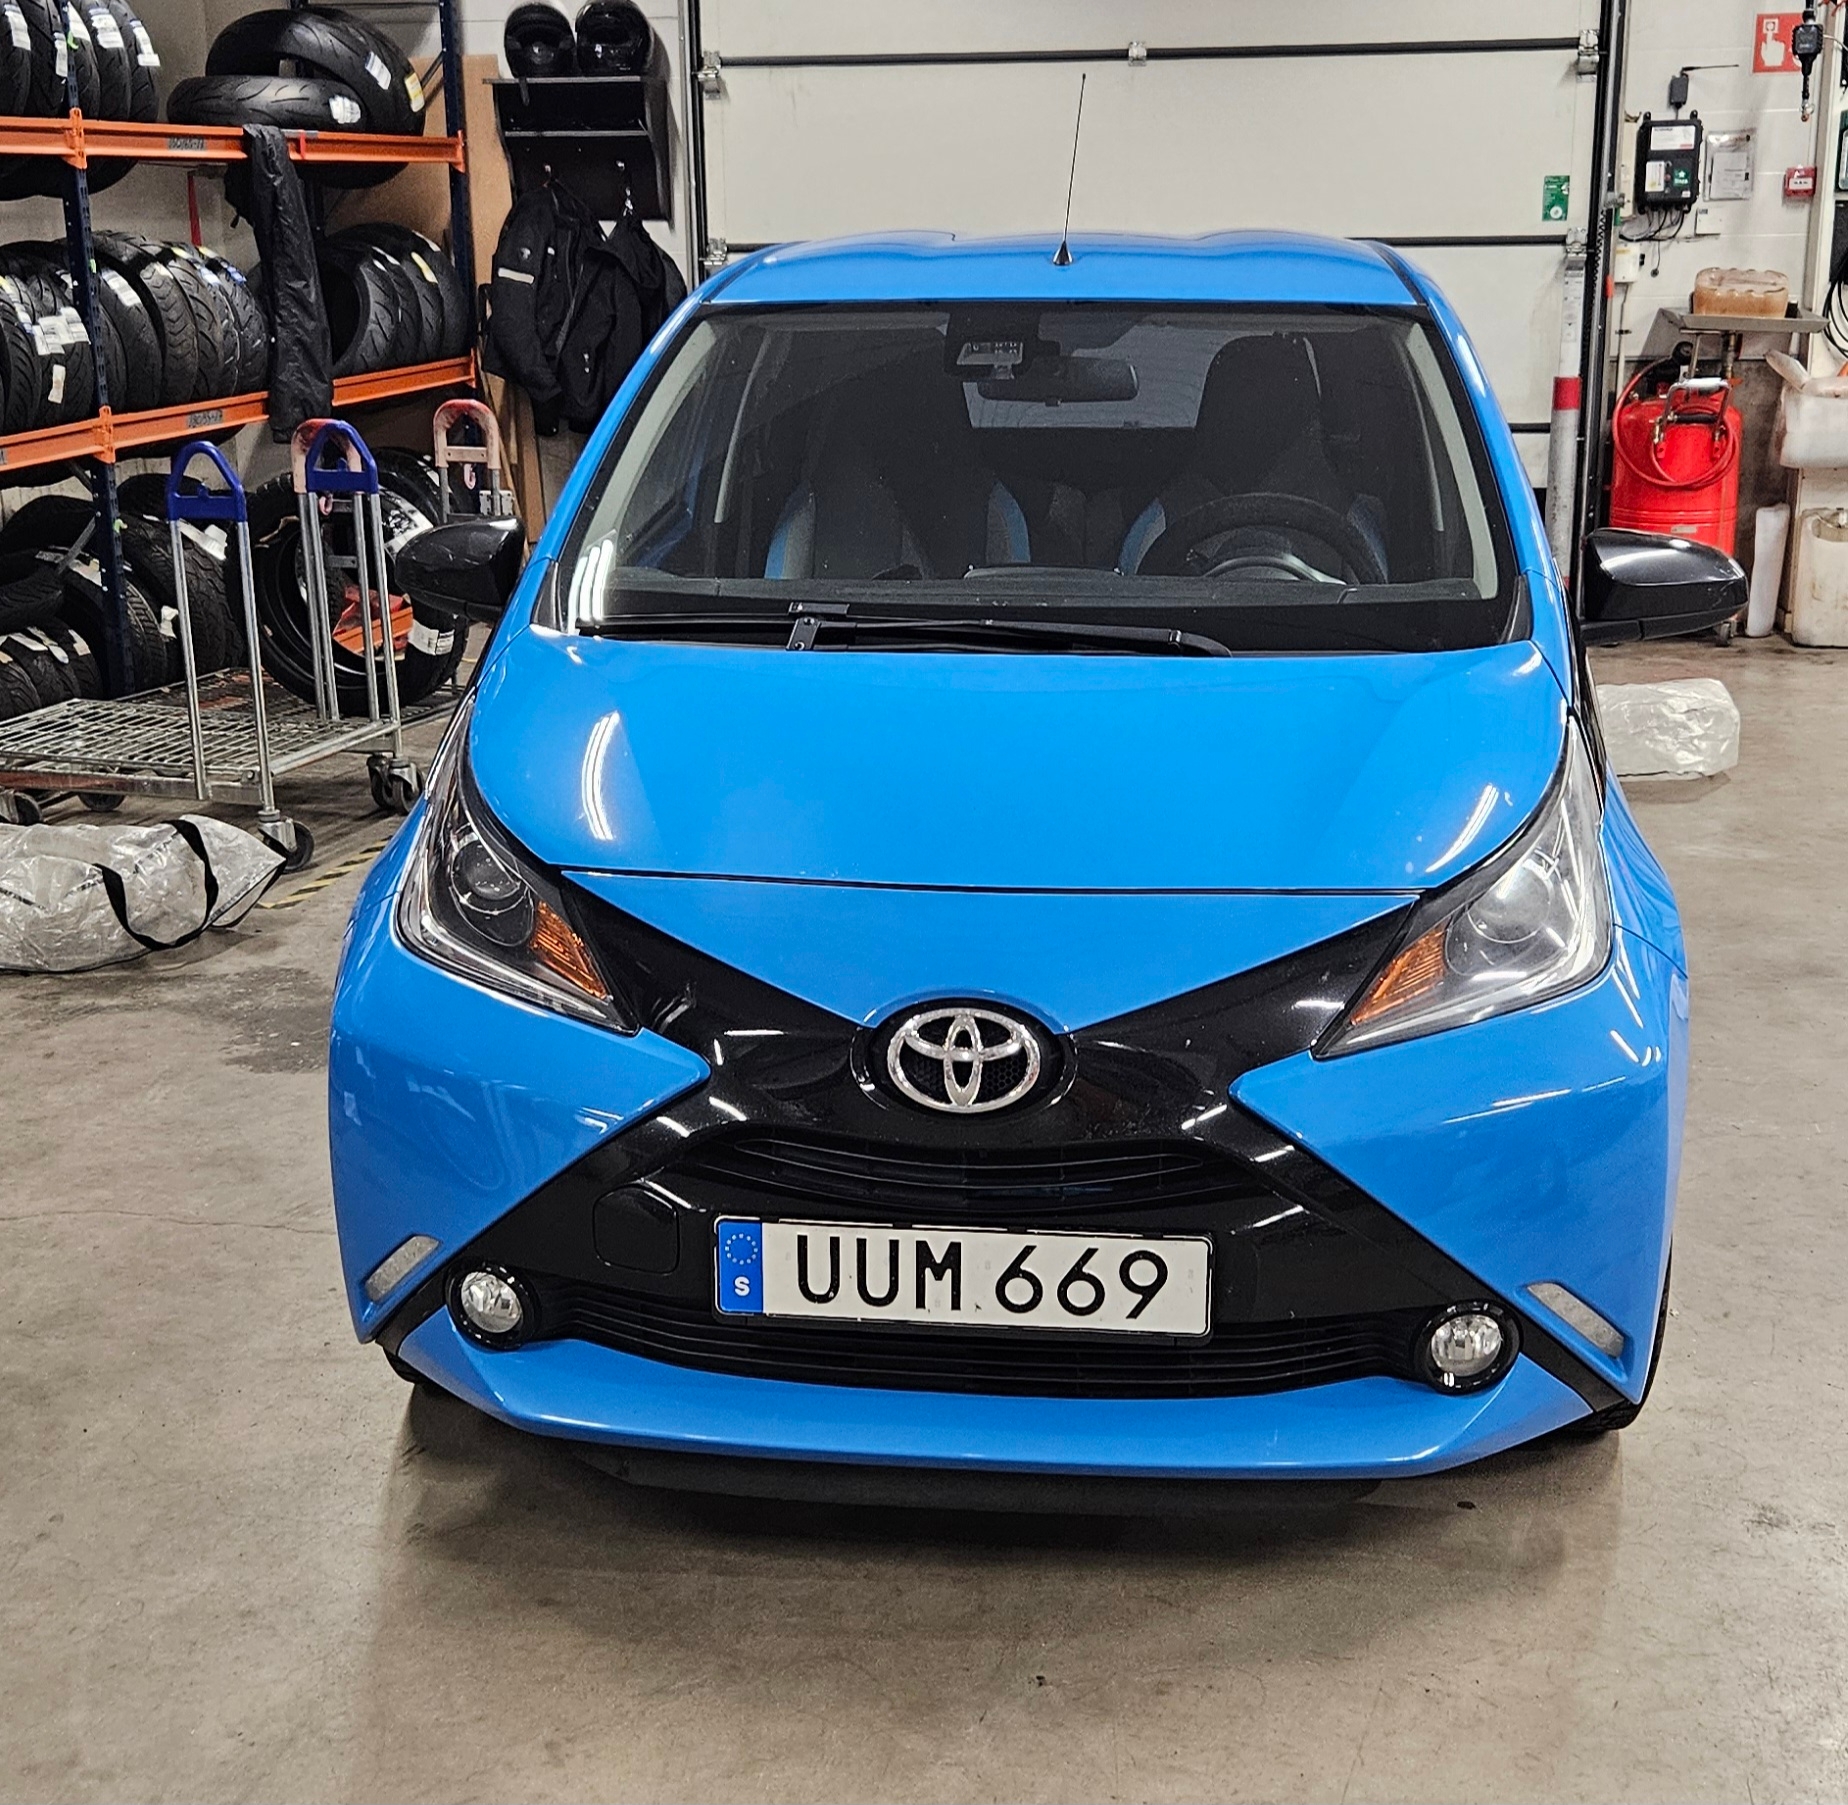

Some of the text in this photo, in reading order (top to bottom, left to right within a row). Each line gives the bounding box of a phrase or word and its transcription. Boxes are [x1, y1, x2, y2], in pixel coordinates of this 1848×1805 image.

[734, 1276, 750, 1297] S
[796, 1234, 1168, 1320] UUM 669
